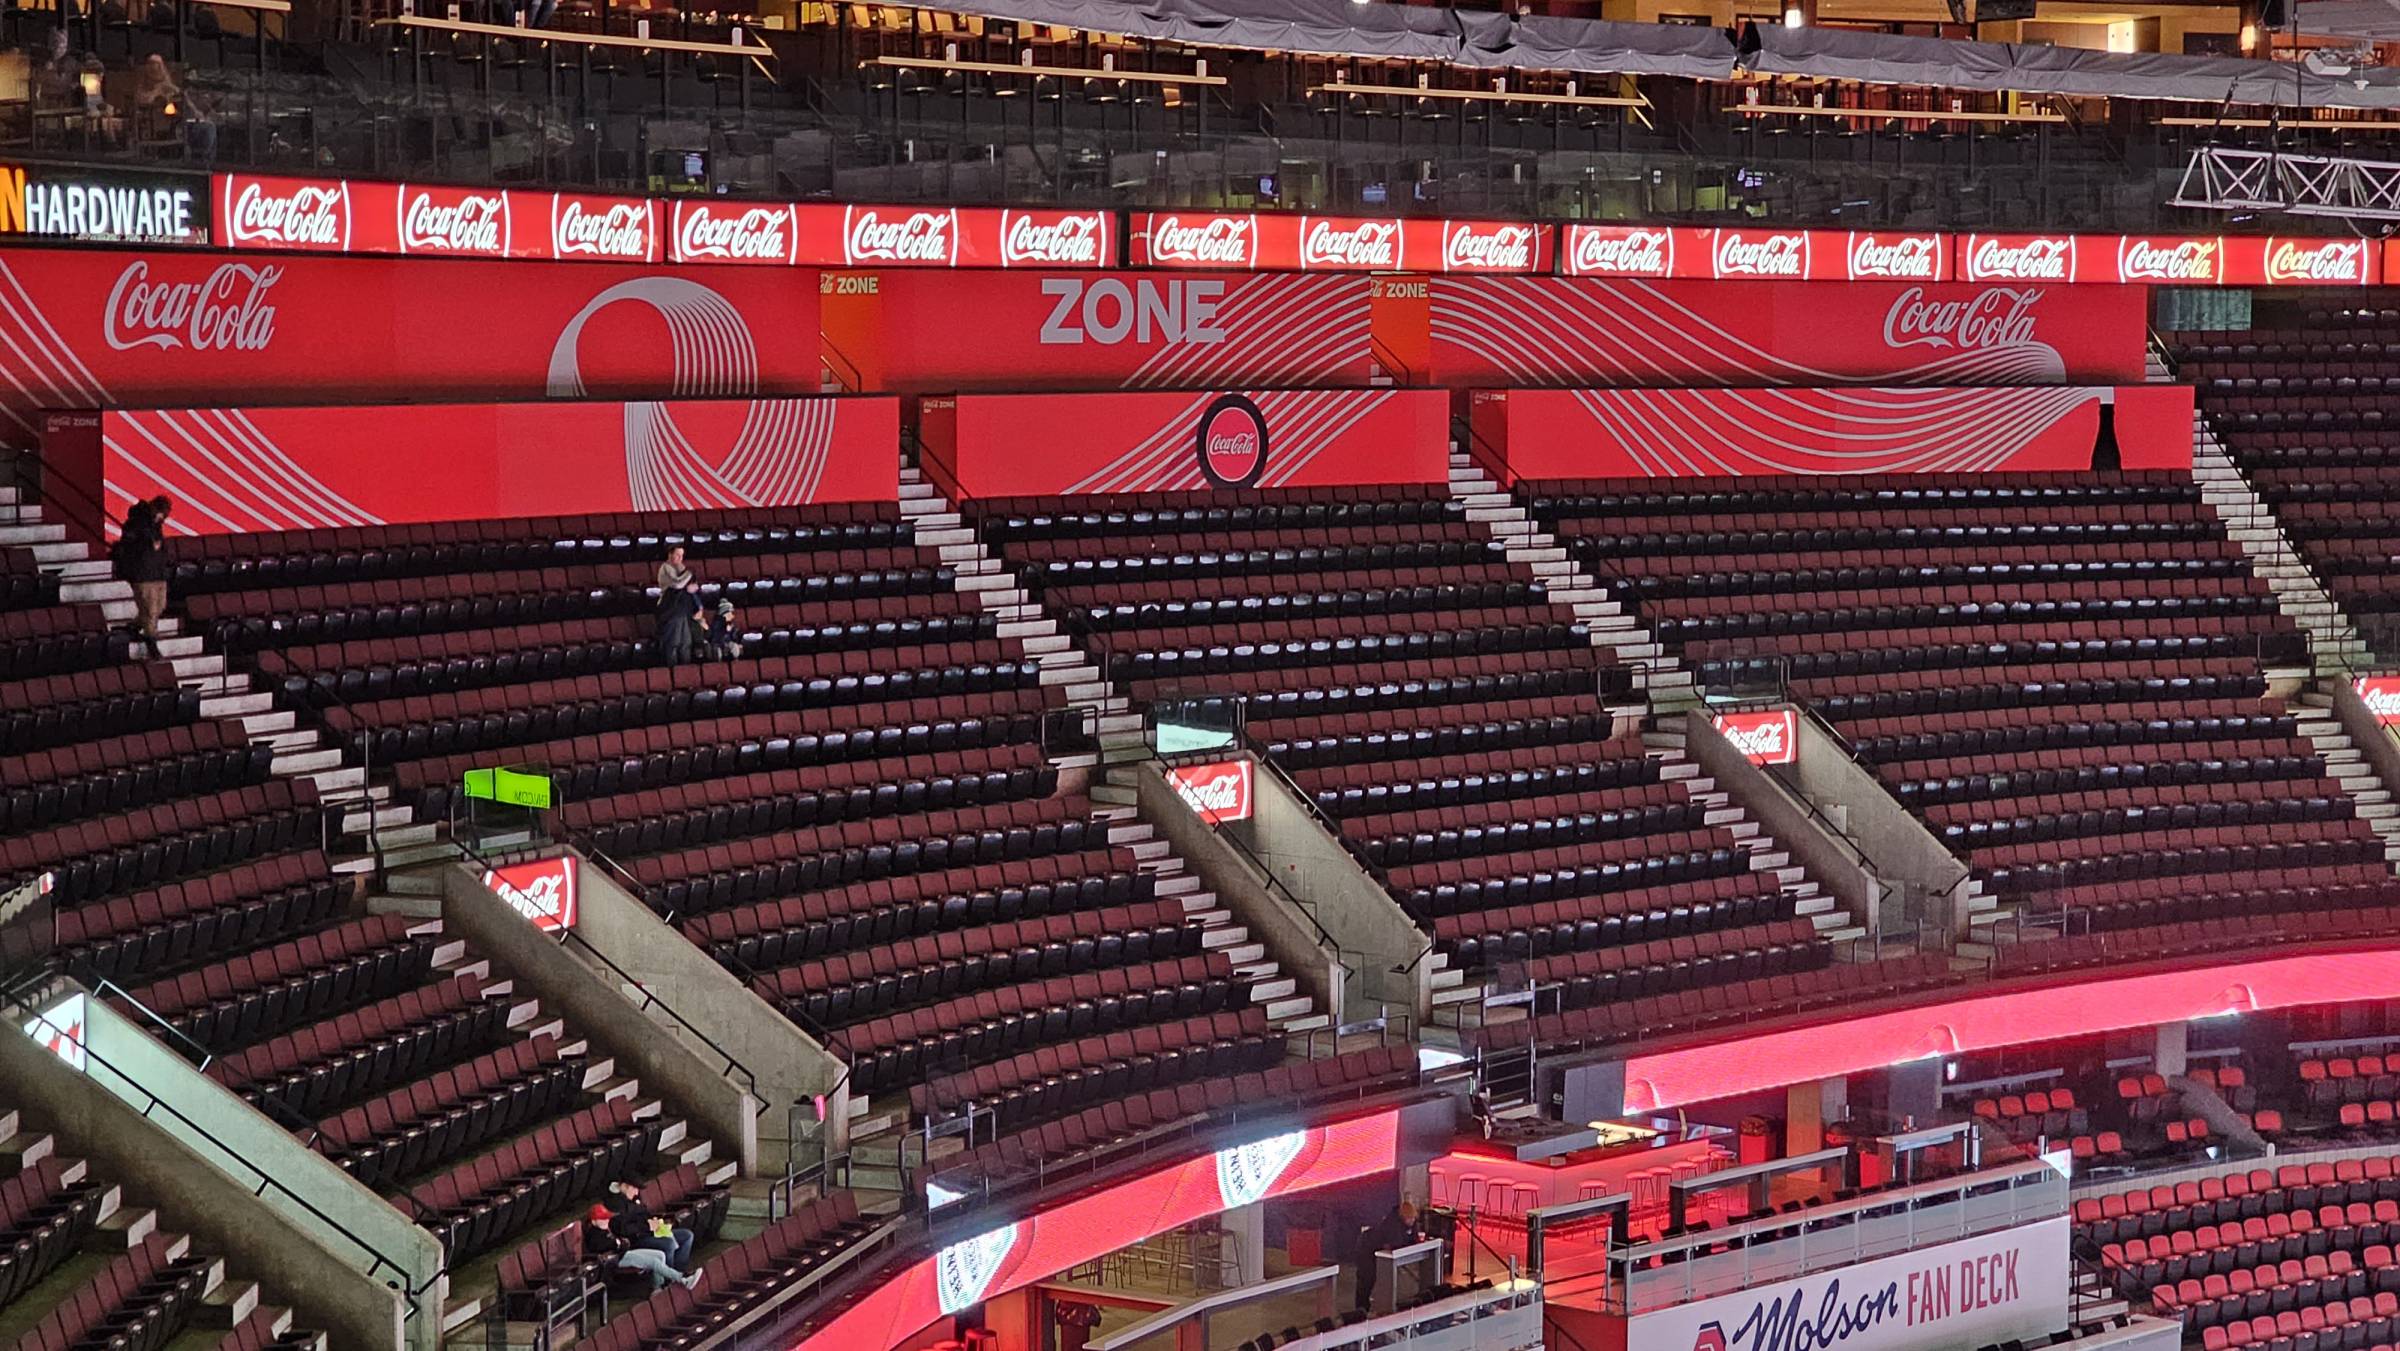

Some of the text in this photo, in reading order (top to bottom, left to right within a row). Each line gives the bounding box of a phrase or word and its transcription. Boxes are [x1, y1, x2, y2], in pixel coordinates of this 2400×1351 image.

[25, 184, 192, 236] HARDWARE
[234, 184, 340, 243] Coca-Cola
[406, 193, 500, 250] Coca-Cola
[559, 202, 645, 255] Coca-Cola
[682, 207, 788, 258] Coca-Cola
[851, 212, 949, 259] Coca-Cola
[1007, 215, 1097, 260] Coca-Cola
[1154, 217, 1248, 262] Coca-Cola
[1305, 221, 1395, 264] Coca-Cola
[1449, 226, 1532, 267] Coca-Cola
[1577, 231, 1665, 274] Coca-Cola
[1719, 234, 1802, 275] Coca-Cola
[1853, 238, 1934, 277] Coca-Cola
[1973, 239, 2066, 278] Coca-Cola
[2125, 241, 2214, 278] Coca-Cola
[2270, 242, 2361, 279] Coca-Cola
[104, 260, 284, 350] Coca-Cola
[837, 277, 879, 294] ZONE
[1386, 282, 1428, 298] ZONE
[1040, 278, 1226, 344] ZONE
[1883, 287, 2045, 349] Coca-Cola
[1209, 432, 1256, 456] Coca-Cola
[1732, 1248, 2019, 1351] Molson FAN DECK
